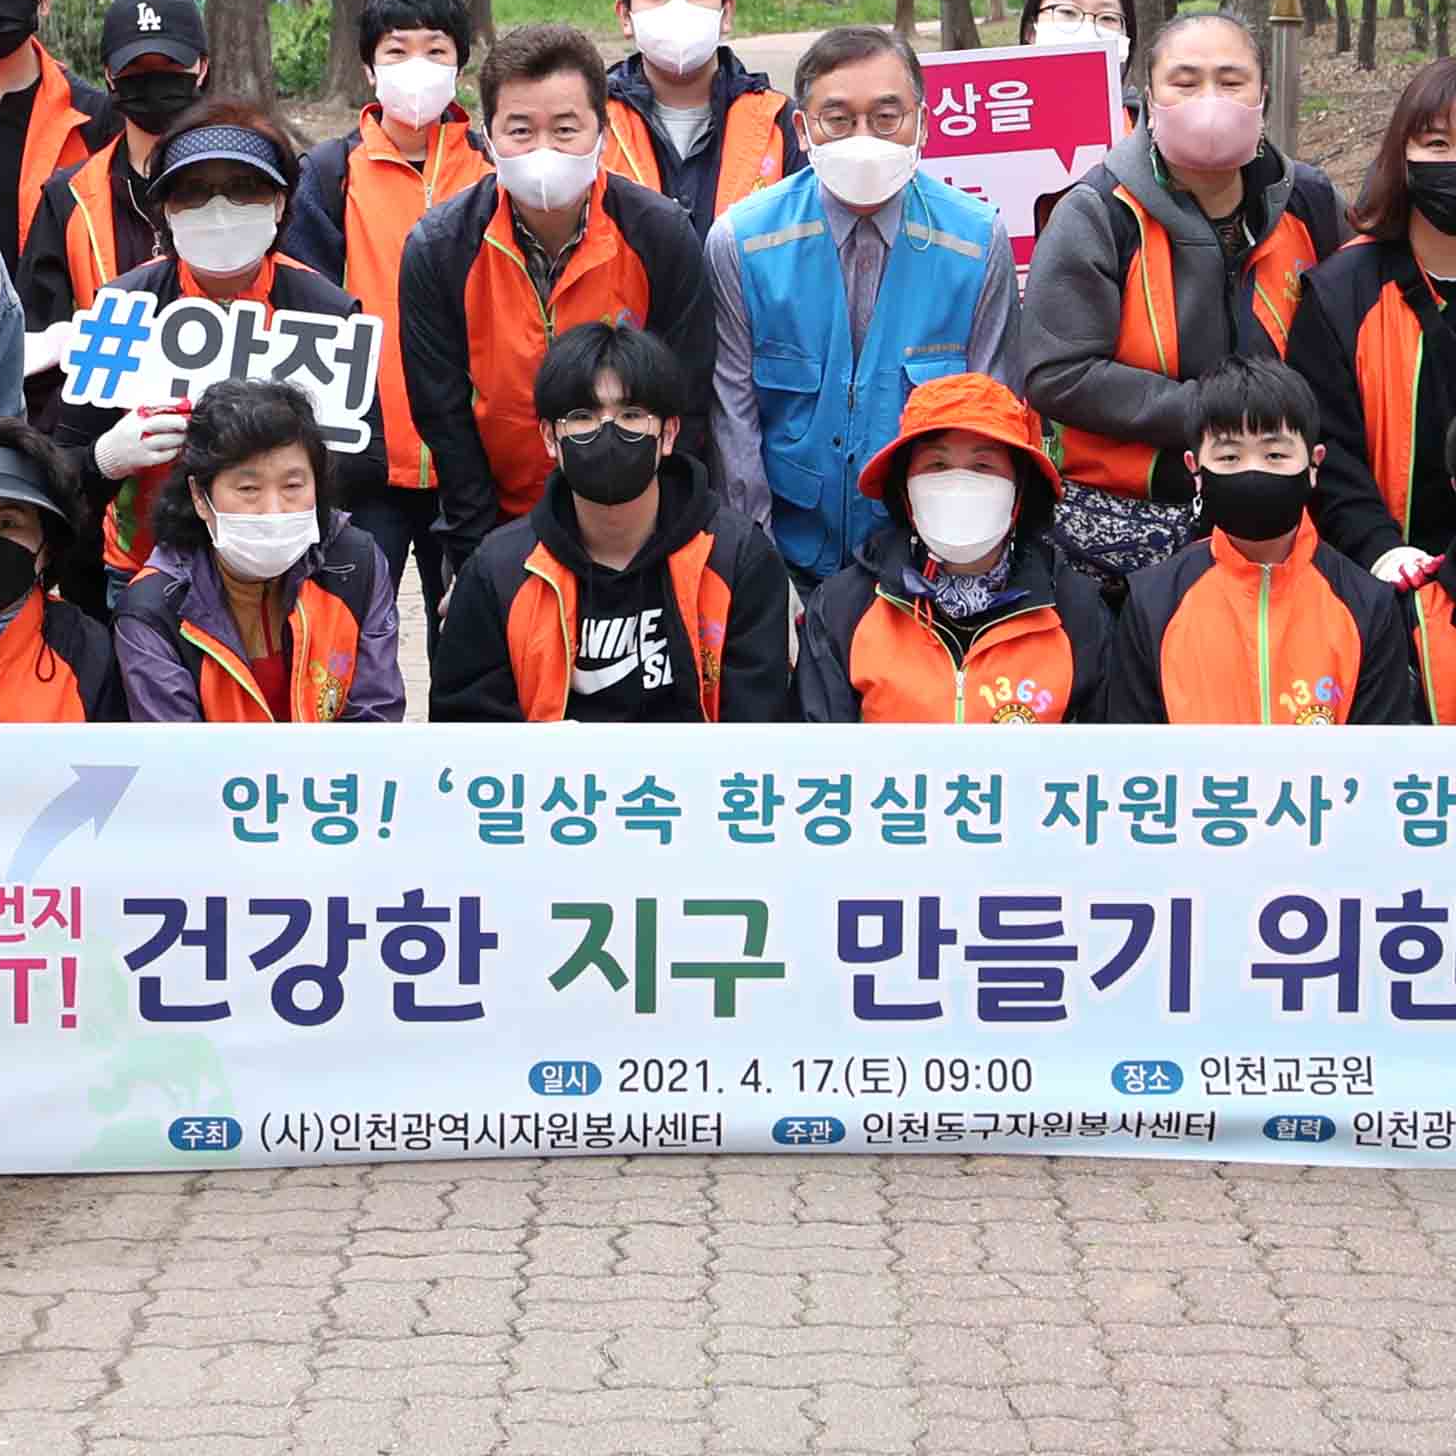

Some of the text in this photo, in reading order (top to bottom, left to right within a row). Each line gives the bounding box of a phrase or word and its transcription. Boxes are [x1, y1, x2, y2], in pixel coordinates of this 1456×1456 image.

[136, 2, 162, 31] LA
[69, 297, 375, 444] #안전
[577, 608, 663, 662] NIKE
[979, 676, 1054, 713] 1365
[222, 773, 398, 843] 안녕!
[718, 773, 1003, 844] 환경실천
[122, 888, 499, 1026] 건강한
[548, 897, 786, 1018] 지구
[837, 895, 1193, 1022] 만들기
[541, 1057, 1033, 1098] 일시 2021. 4. 17.(토) 09:00
[1122, 1056, 1375, 1097] 장소 인천교공원
[180, 1111, 722, 1153] 주최 (사)인천광역시자원봉사센터
[785, 1111, 1217, 1145] 주관 인천동구자원봉사센터
[1275, 1115, 1327, 1143] 협력
